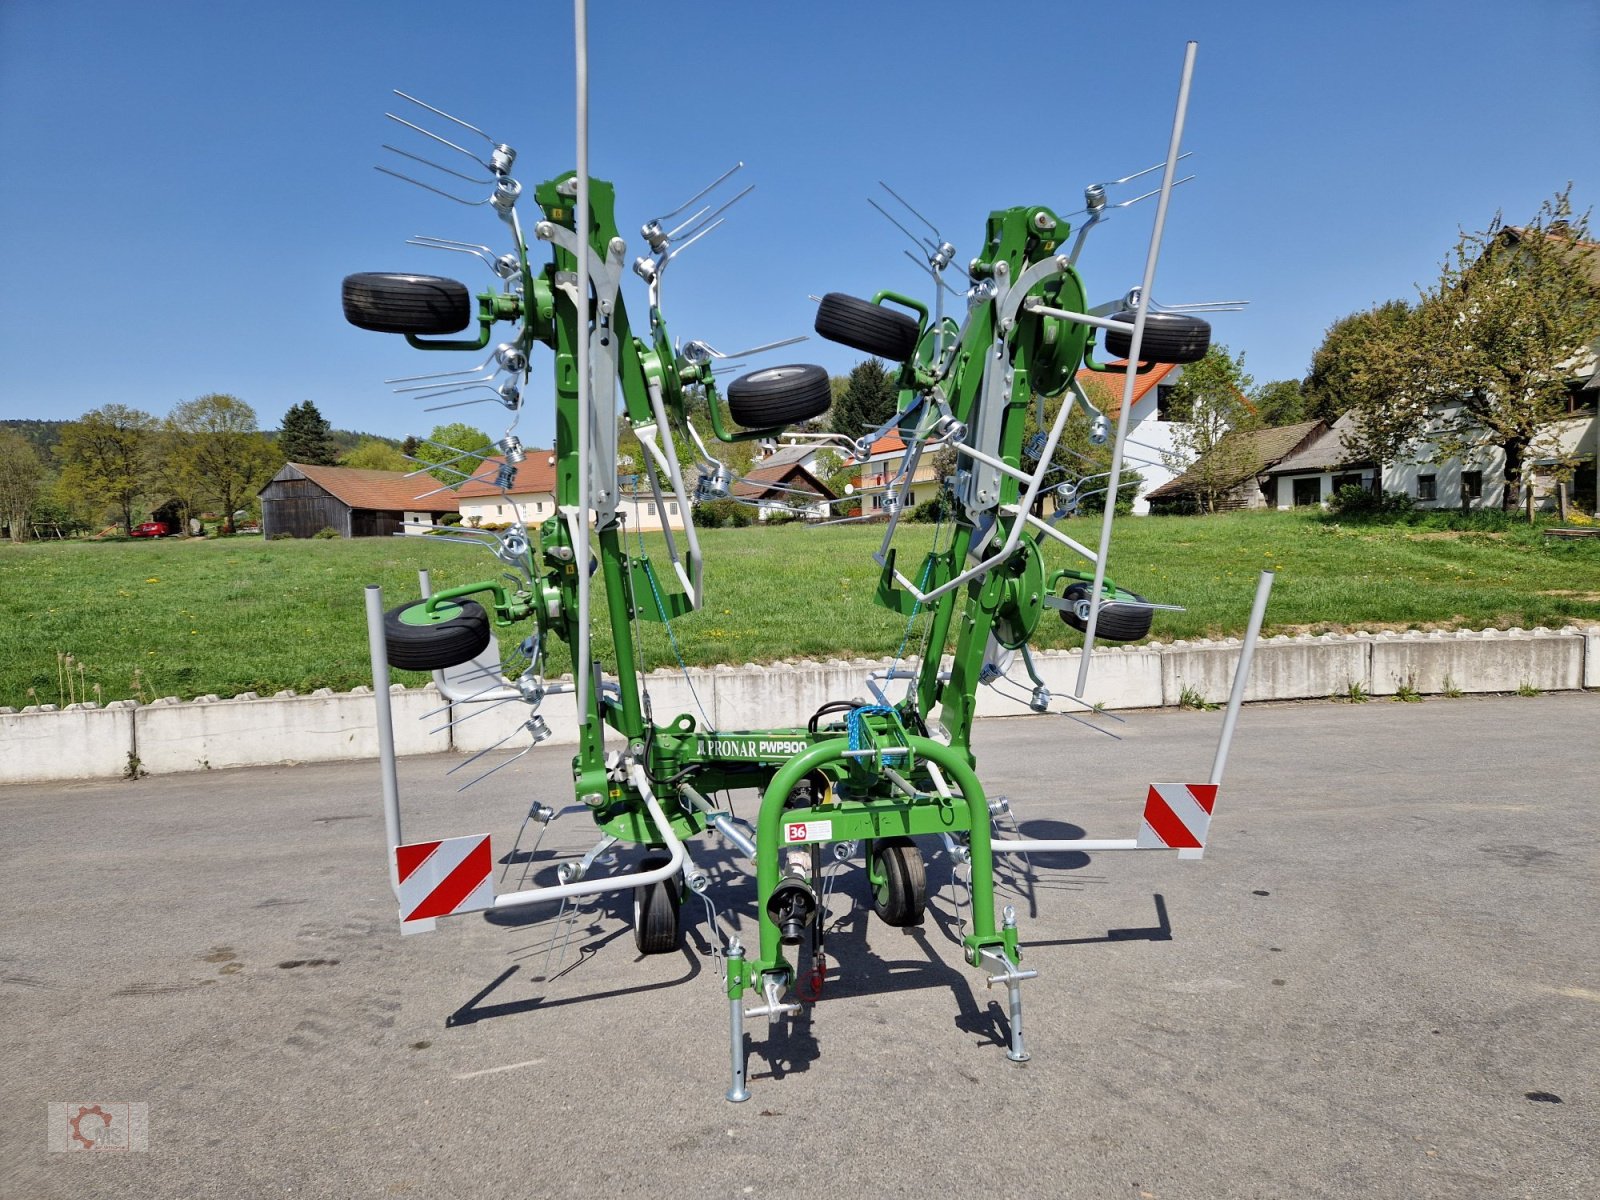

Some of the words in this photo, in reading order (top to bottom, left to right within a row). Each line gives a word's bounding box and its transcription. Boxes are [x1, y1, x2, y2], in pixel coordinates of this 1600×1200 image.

[708, 740, 757, 757] PRONAR
[759, 741, 807, 753] PWP900
[790, 826, 806, 839] 36
